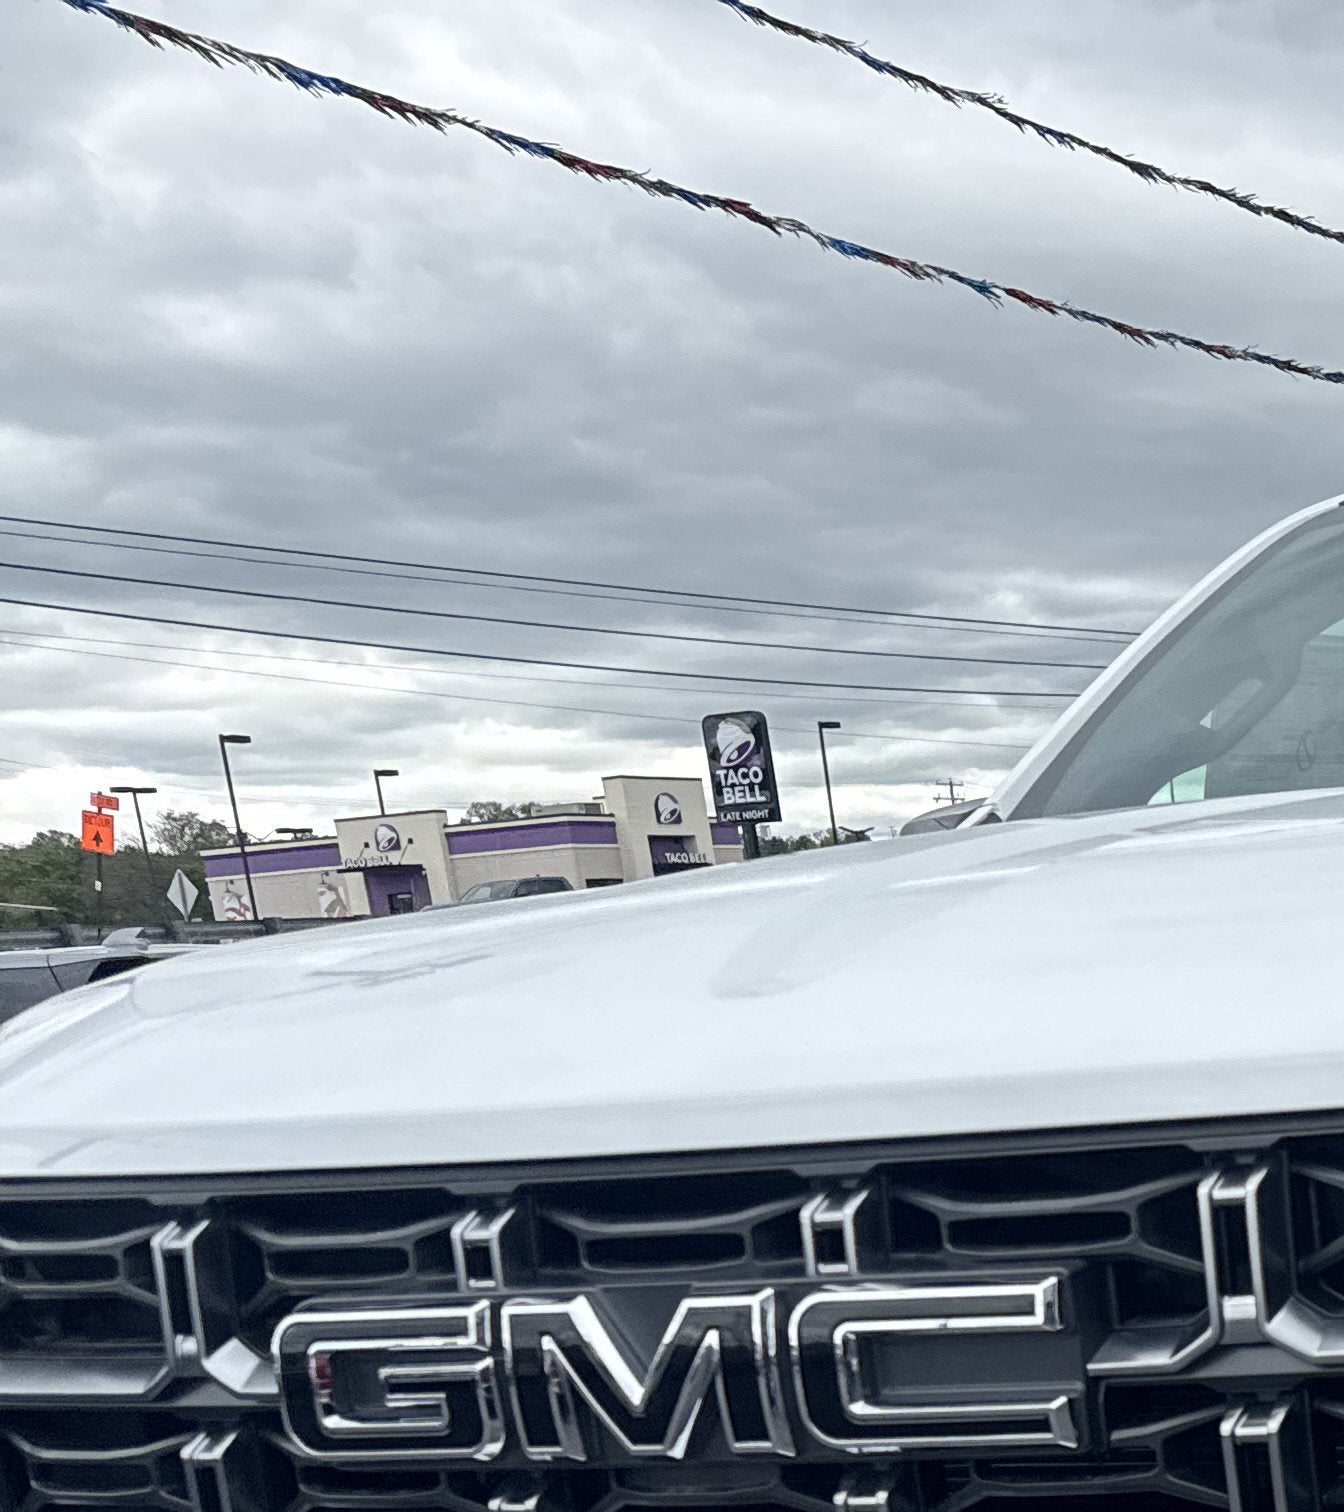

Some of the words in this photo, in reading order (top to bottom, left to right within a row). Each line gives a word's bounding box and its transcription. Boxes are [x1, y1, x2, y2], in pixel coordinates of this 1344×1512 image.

[716, 766, 763, 786] TACO
[722, 786, 767, 805] BELL
[720, 812, 742, 822] LATE
[742, 809, 769, 821] NIGHT
[344, 857, 367, 868] TACO
[665, 852, 688, 864] TACO
[689, 852, 707, 863] BELL
[271, 1276, 1078, 1461] GMC
